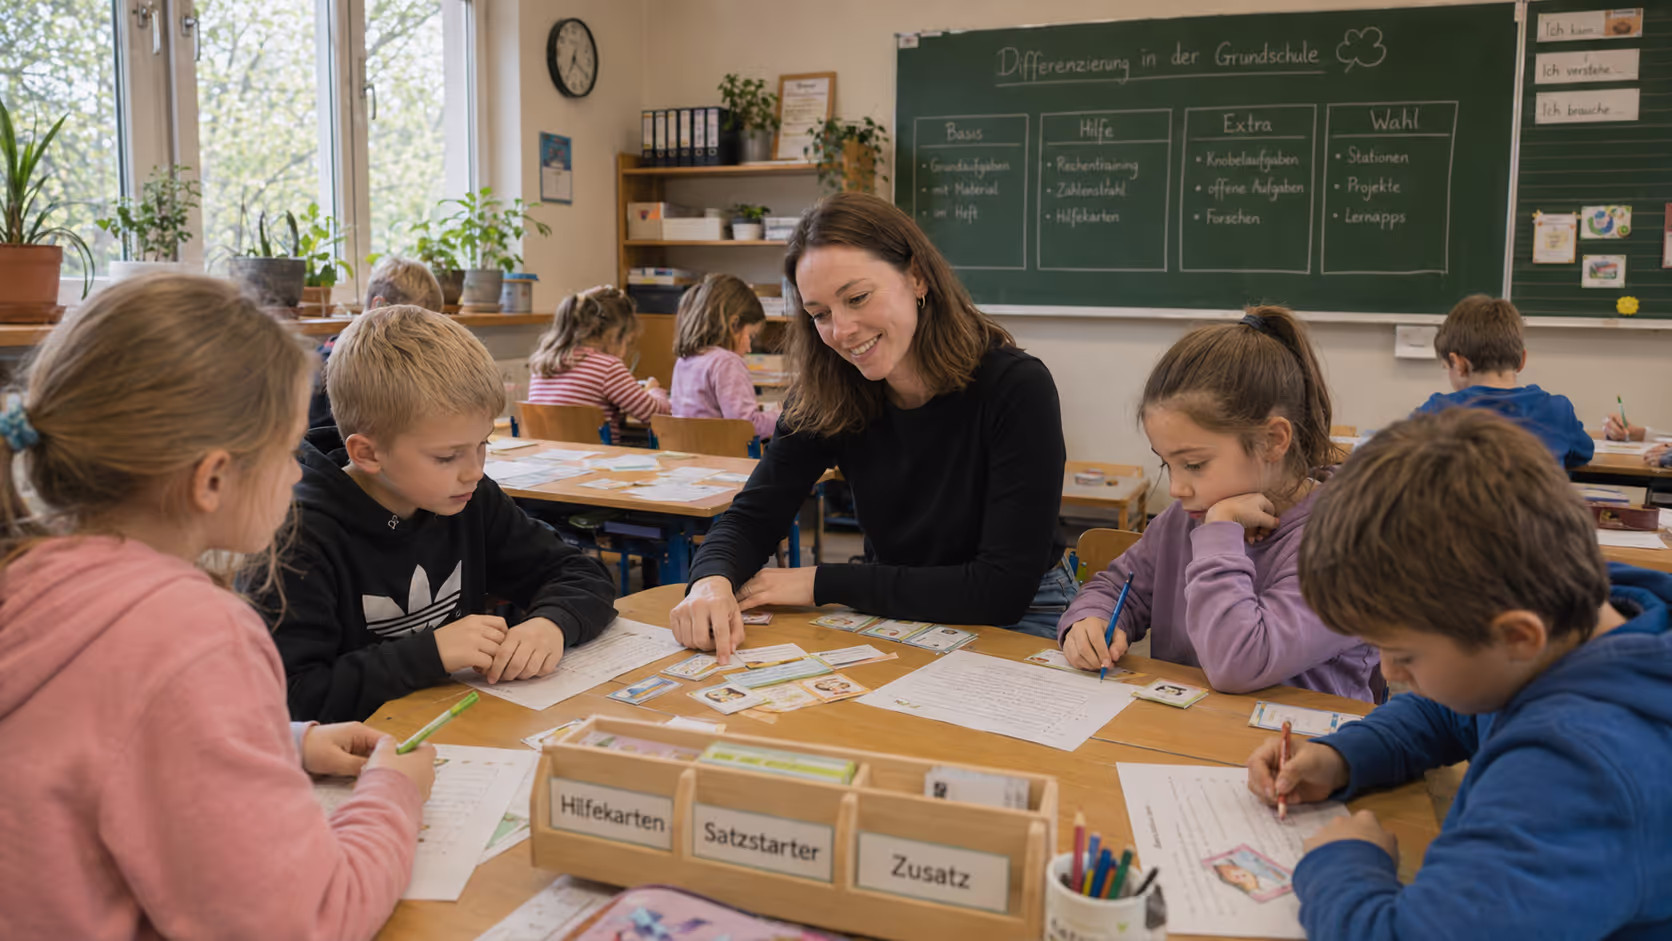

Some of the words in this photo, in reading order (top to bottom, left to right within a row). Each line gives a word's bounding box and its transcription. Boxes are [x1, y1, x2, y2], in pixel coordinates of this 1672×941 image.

[1545, 22, 1564, 37] Ich
[996, 46, 1130, 84] Differenzierung
[1141, 49, 1156, 67] in
[1171, 41, 1200, 66] der
[1214, 40, 1320, 66] Grundschule
[1542, 64, 1560, 77] Ich
[1567, 63, 1610, 77] verstehe
[1370, 108, 1420, 130] Wahl
[1542, 102, 1561, 117] Ich
[1567, 102, 1610, 116] brauche
[945, 121, 983, 142] Basis
[1080, 118, 1114, 144] Hilfe
[1223, 112, 1273, 133] Extra
[1206, 151, 1299, 172] Knobelaufgaben
[1348, 147, 1409, 164] Stationen
[930, 157, 1010, 178] Grundaufgaben
[1056, 155, 1139, 180] Rechentraining
[954, 180, 998, 195] Material
[1207, 178, 1246, 200] offene
[1252, 179, 1304, 201] Aufgaben
[1347, 177, 1401, 201] Projekte
[955, 204, 978, 224] Heft
[1056, 206, 1120, 228] Hilfekarten
[1206, 208, 1260, 225] Forschen
[1345, 207, 1406, 230] Lernapps
[560, 794, 666, 833] Hilfekarten
[704, 821, 821, 862] Satzstarter
[890, 853, 971, 890] Zusatz
